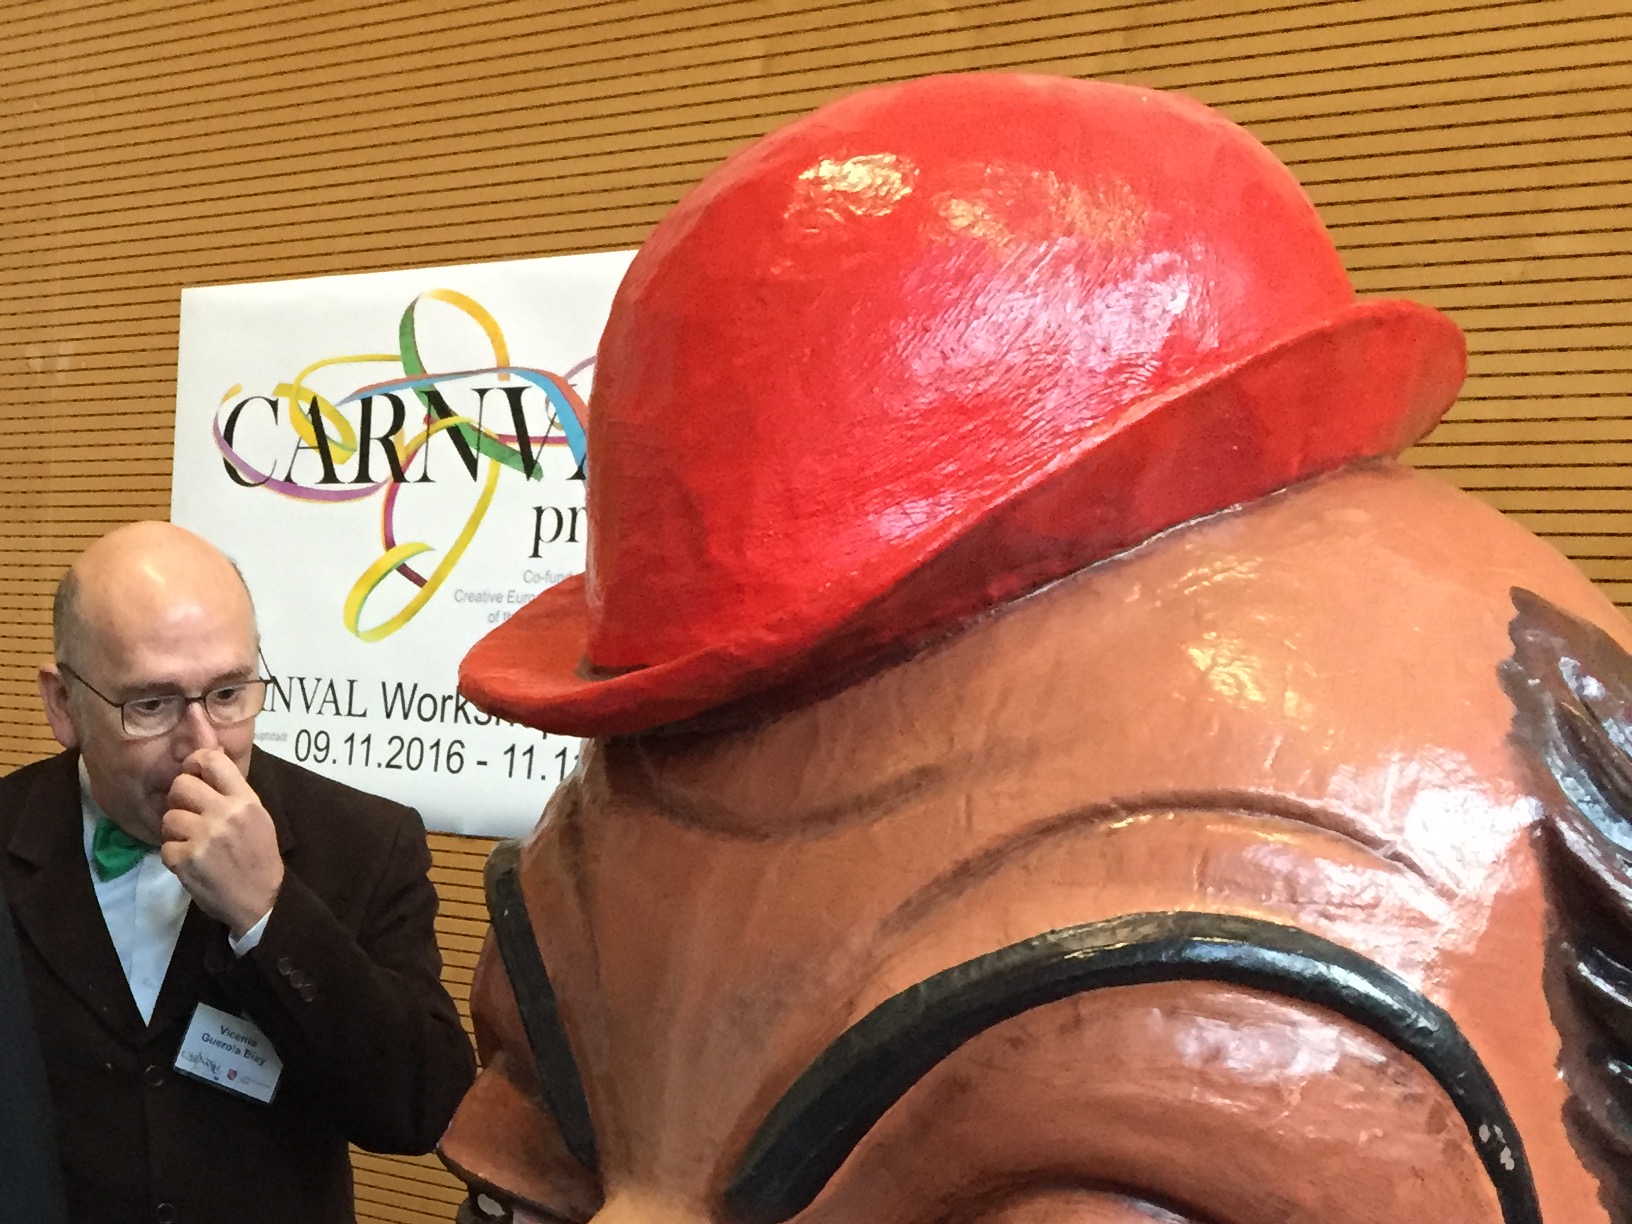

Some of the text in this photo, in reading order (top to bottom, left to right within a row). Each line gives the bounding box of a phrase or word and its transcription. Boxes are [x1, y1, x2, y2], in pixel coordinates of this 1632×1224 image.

[454, 588, 503, 603] Creative
[488, 610, 500, 623] of
[261, 675, 368, 718] NVAL
[294, 728, 465, 774] 09.11.2016
[503, 743, 580, 782] 11.1
